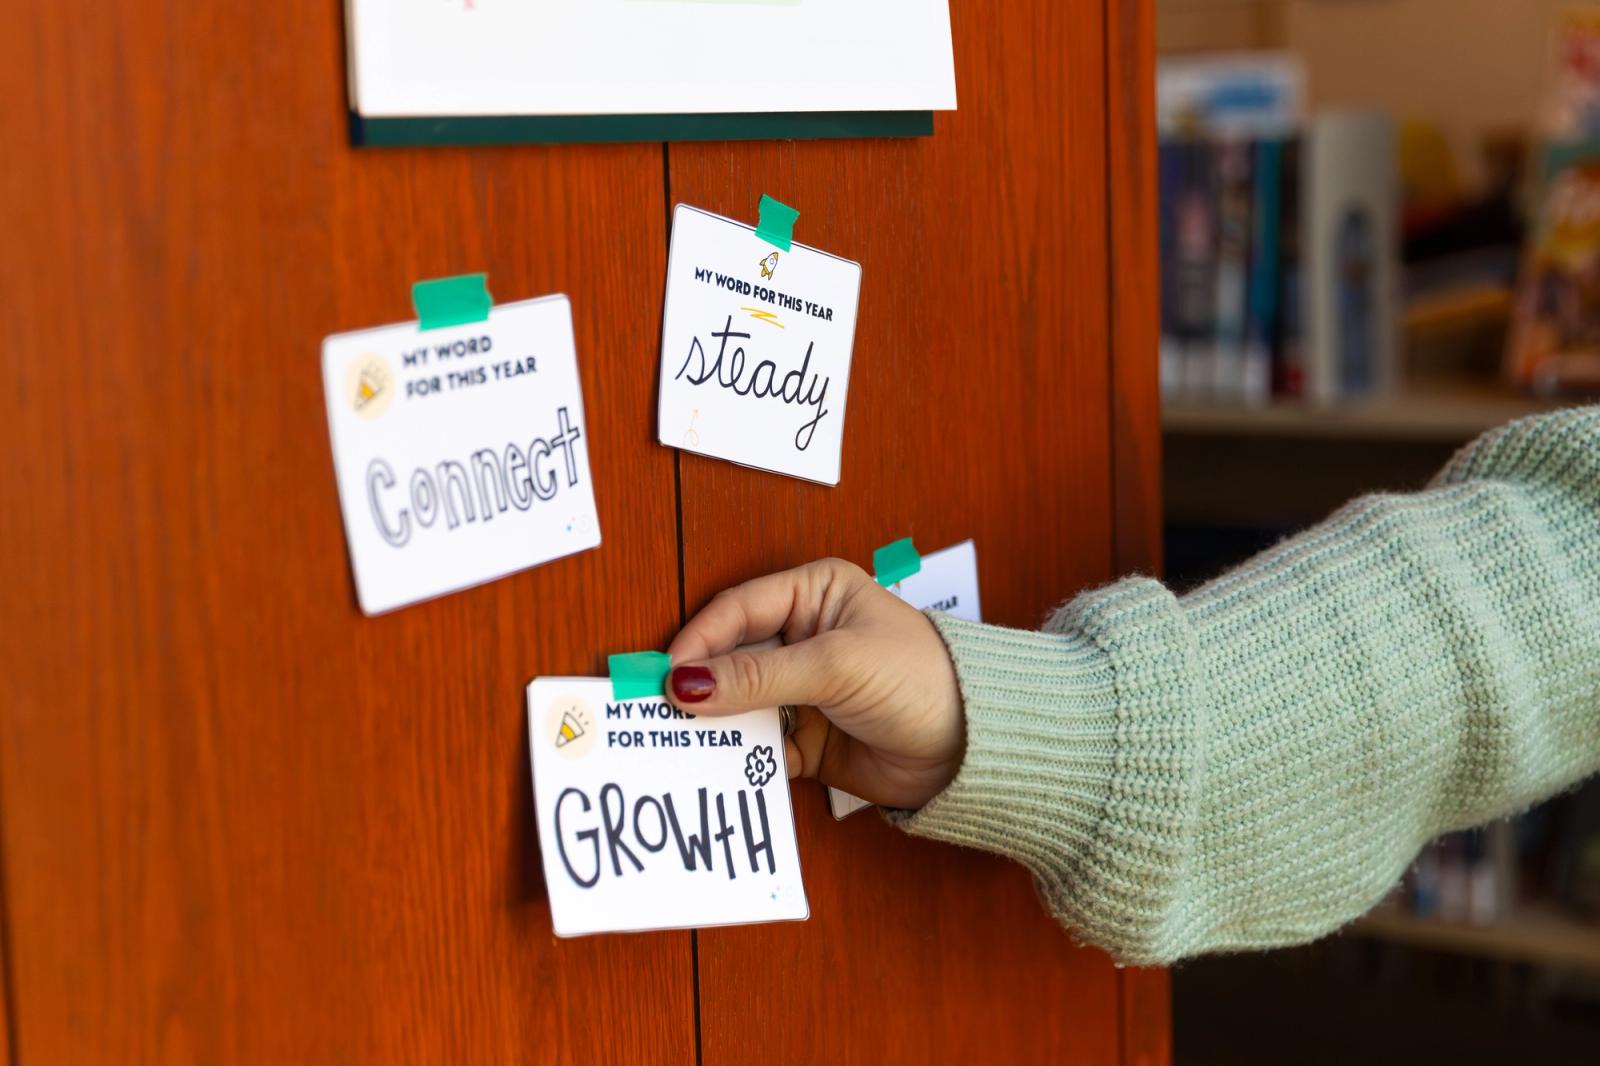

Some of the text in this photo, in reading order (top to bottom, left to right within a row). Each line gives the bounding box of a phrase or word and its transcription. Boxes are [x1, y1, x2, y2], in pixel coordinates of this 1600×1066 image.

[694, 266, 833, 321] MY WORD FOR THIS YEAR
[402, 335, 492, 368] MY WORD
[406, 356, 536, 399] FOR THIS YEAR
[675, 315, 829, 451] steady
[366, 406, 581, 548] Connect
[606, 703, 633, 719] MY
[607, 730, 743, 747] FOR THIS YEAR
